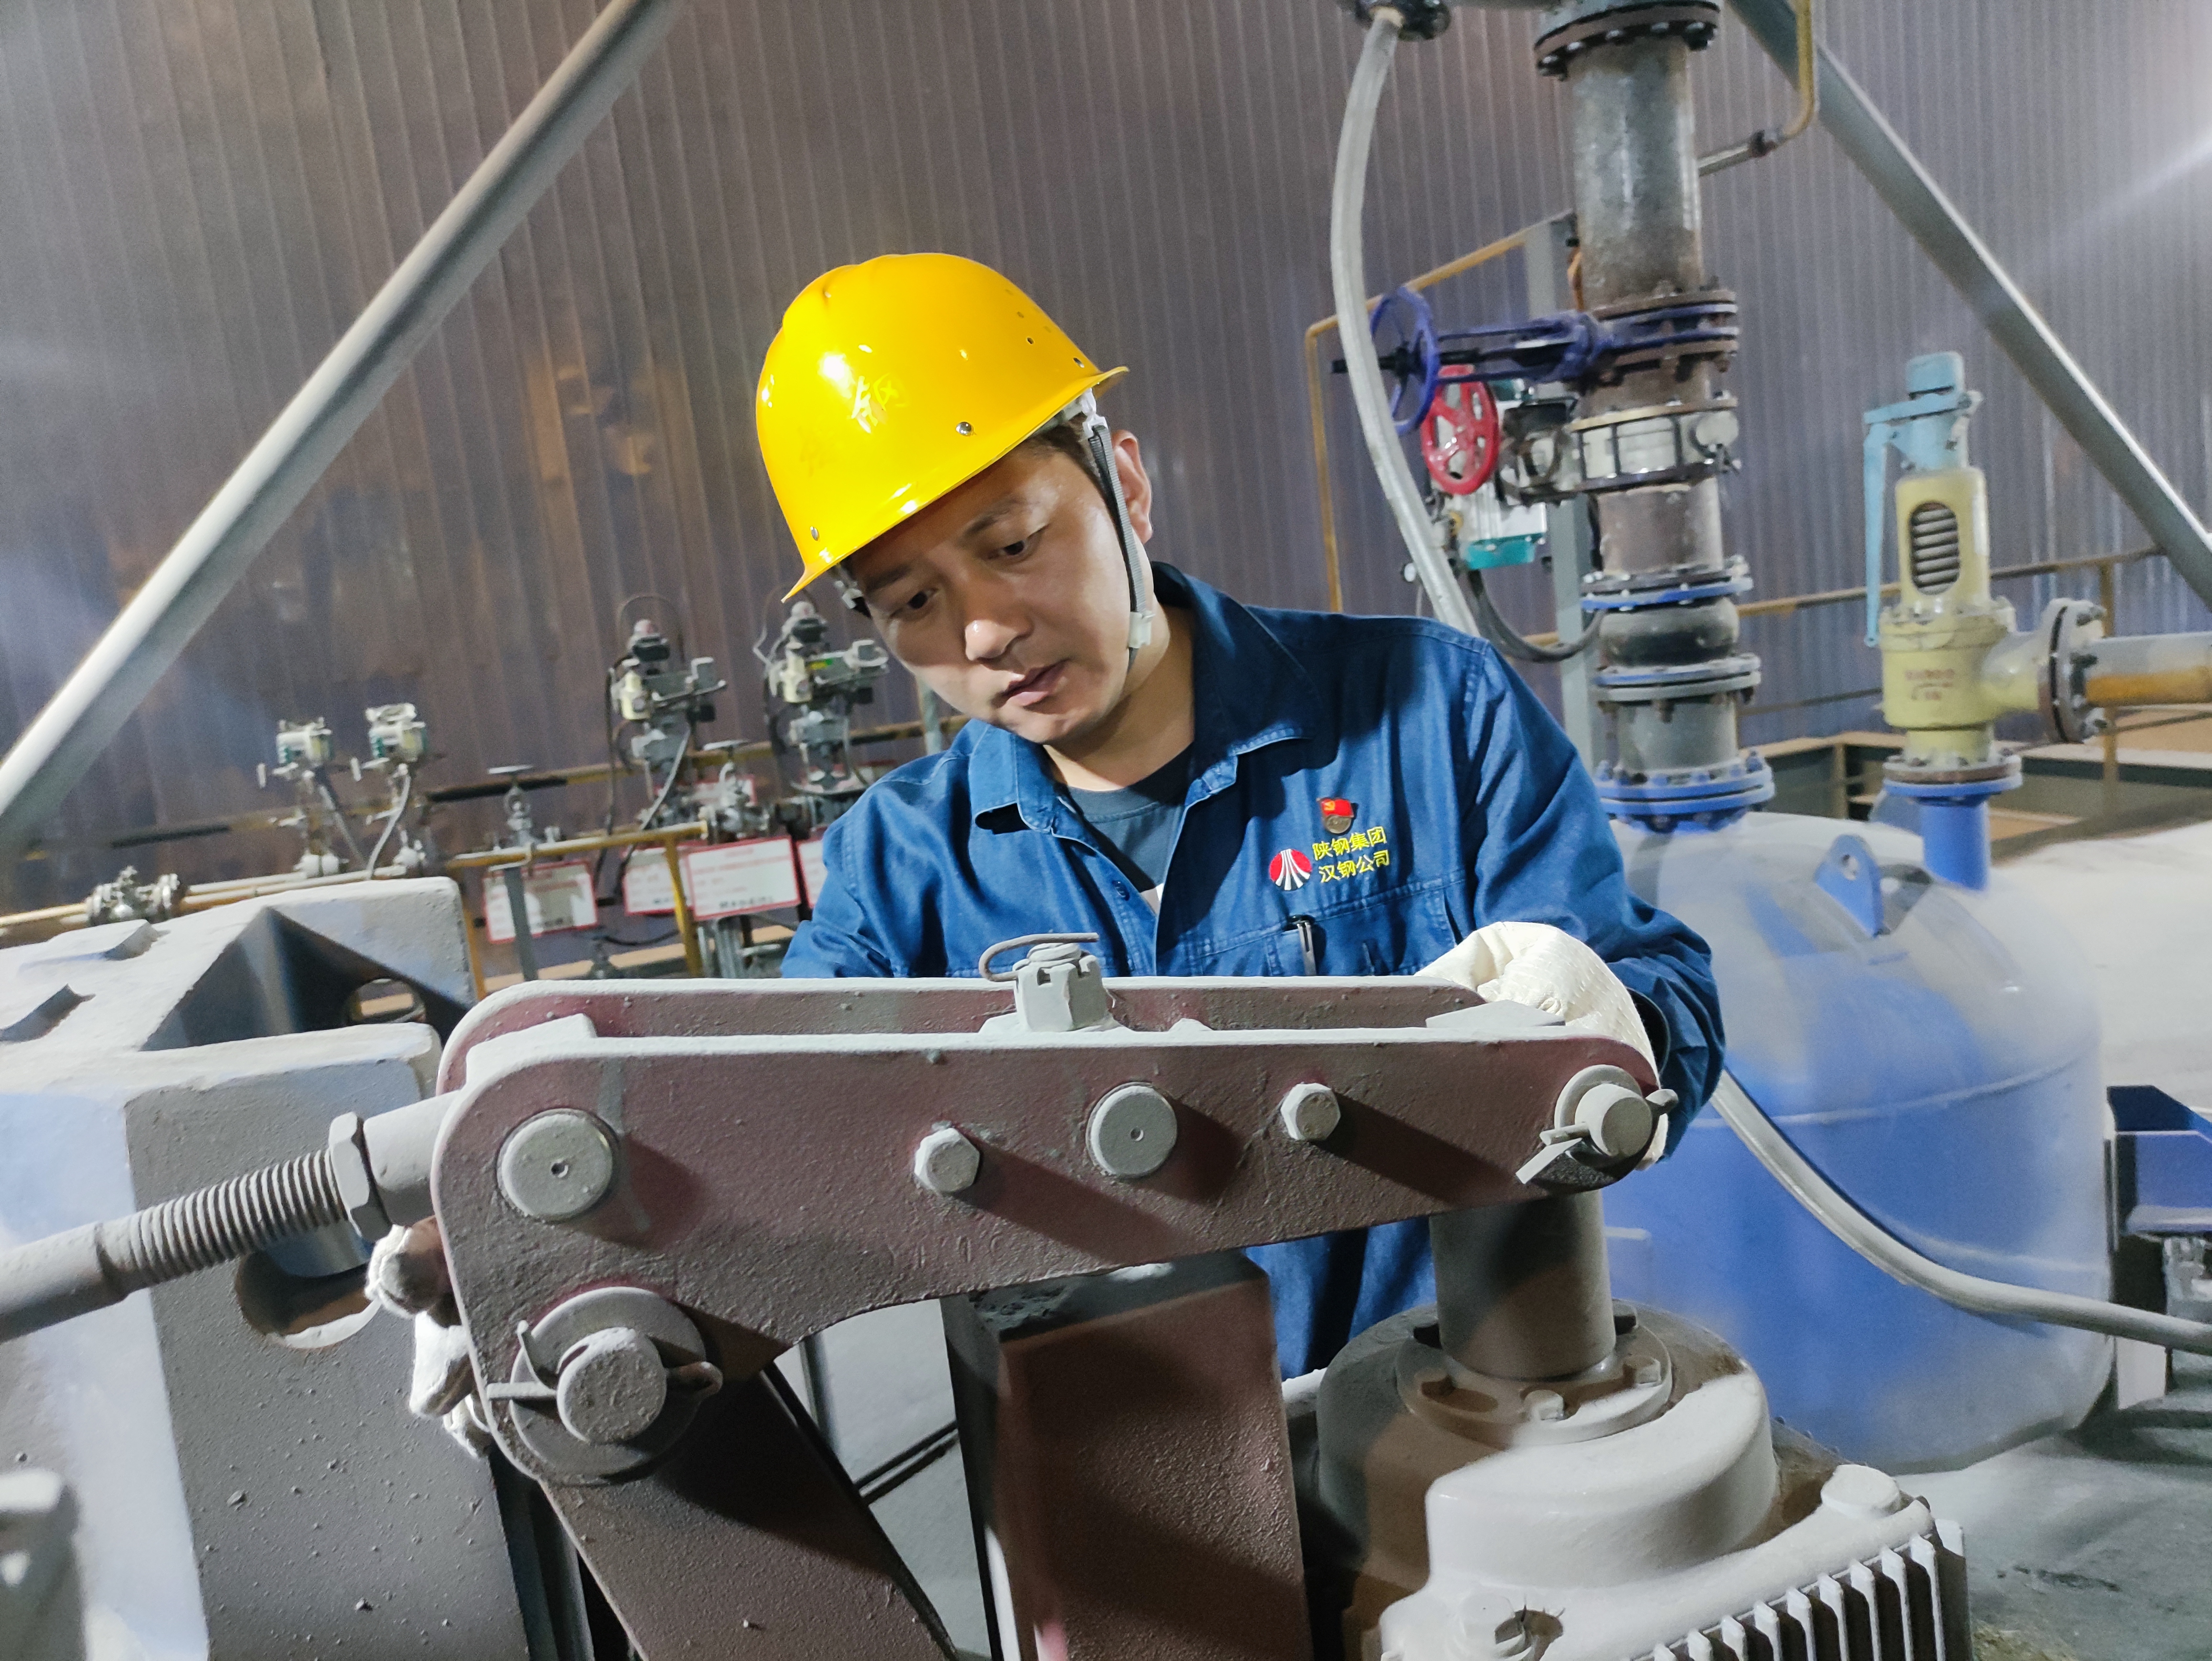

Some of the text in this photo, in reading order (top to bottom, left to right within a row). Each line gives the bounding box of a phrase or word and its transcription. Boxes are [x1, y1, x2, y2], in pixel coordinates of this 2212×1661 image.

[1312, 826, 1387, 861] 陕钢集团
[1318, 850, 1390, 883] 汉钢公司
